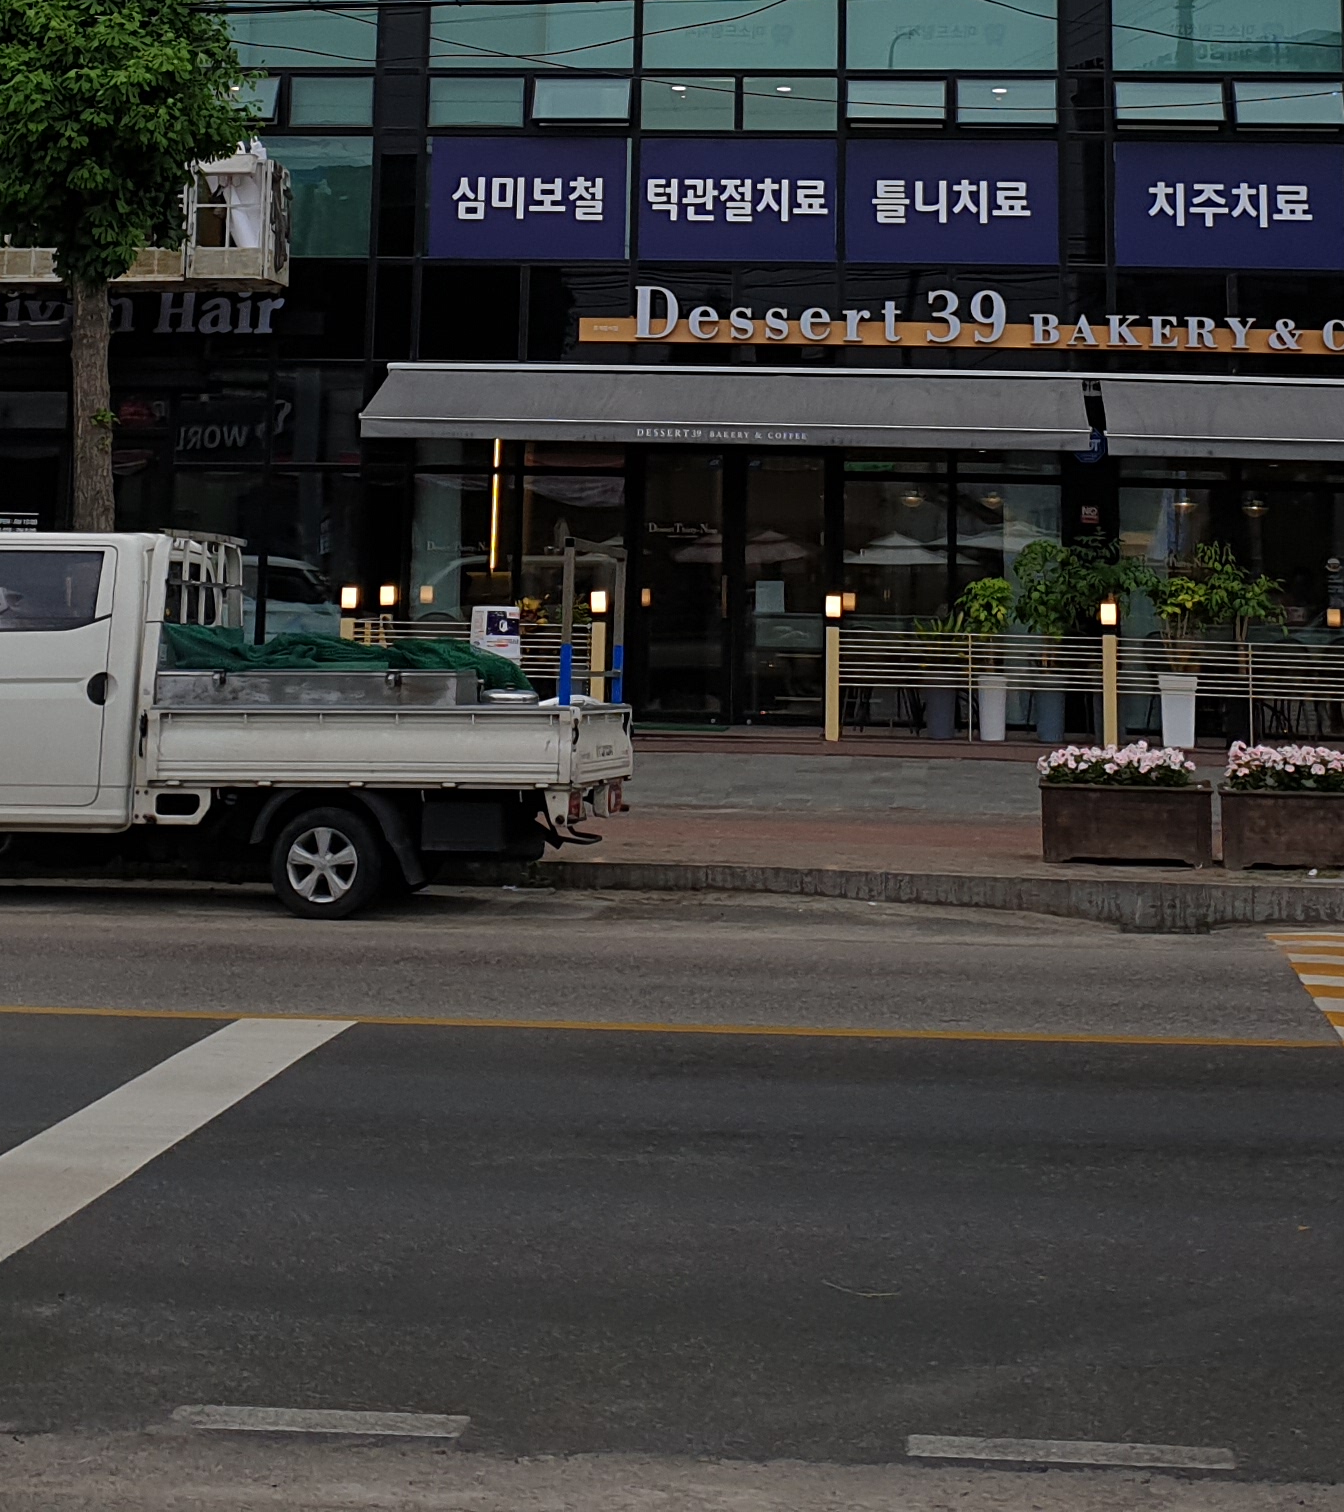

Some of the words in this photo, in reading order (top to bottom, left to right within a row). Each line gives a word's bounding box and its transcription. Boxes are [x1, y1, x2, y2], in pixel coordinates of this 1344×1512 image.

[451, 176, 606, 221] 심미보철
[646, 178, 829, 223] 턱관절치료
[871, 179, 1032, 225] 틀니치료
[1147, 181, 1314, 230] 치주치료
[153, 291, 286, 334] Hair
[634, 285, 903, 343] Dessert
[926, 289, 1008, 344] 39
[1029, 313, 1257, 349] BAKERY
[1267, 317, 1304, 352] &
[709, 430, 750, 439] BAKERY
[767, 431, 808, 440] COFFEE
